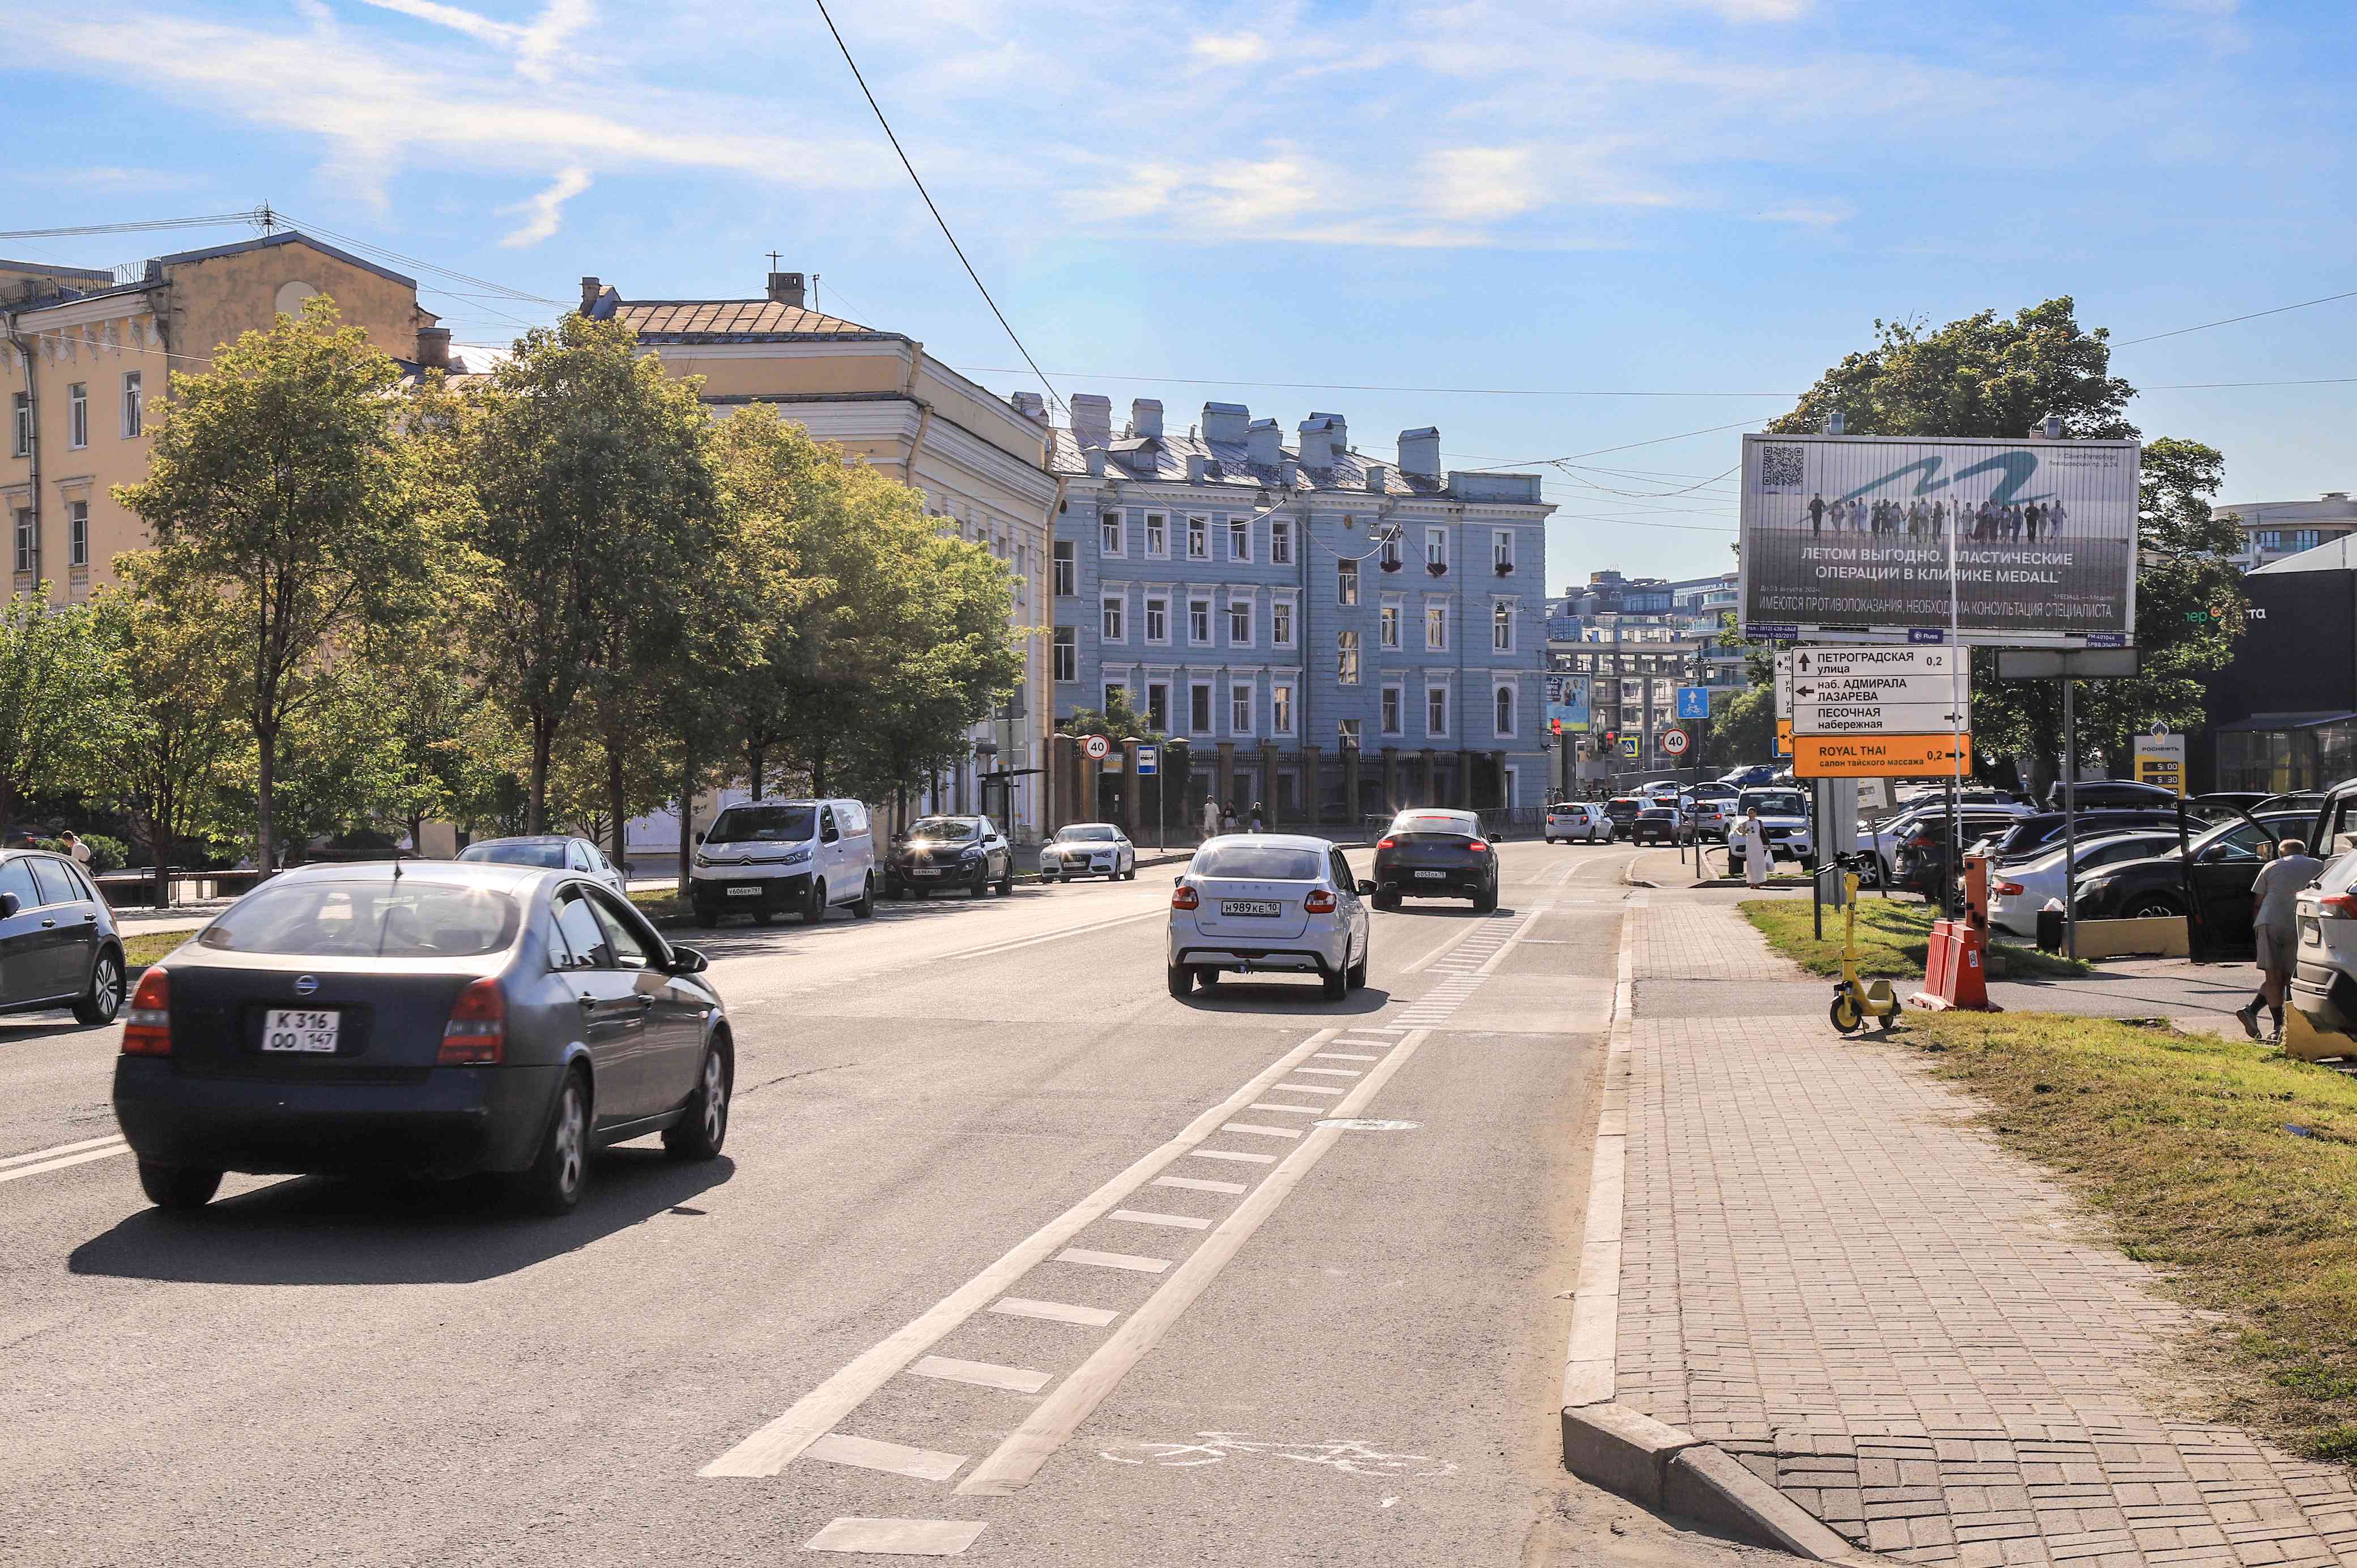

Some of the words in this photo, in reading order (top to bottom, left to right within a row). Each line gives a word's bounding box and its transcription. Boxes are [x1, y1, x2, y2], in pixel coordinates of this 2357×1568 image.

[1801, 547, 1856, 560] ЛЕТОМ
[1861, 548, 1943, 564] ВЫГОДНО.
[1815, 566, 1899, 581] ОПЕРАЦИИ
[1904, 568, 1913, 580] В
[1918, 568, 1992, 582] КЛИНИКЕ
[1759, 596, 1803, 610] ИМЕЮТСЯ
[1806, 597, 1904, 614] ПРОТИВОПОКАЗАНИЯ,
[1972, 601, 2043, 619] КОНСУЛЬТАЦИЯ
[2046, 602, 2113, 620] СПЕЦИАЛИСТА.
[1818, 652, 1913, 663] ПЕТРОГРАДСКАЯ
[1926, 657, 1942, 667] 0,2
[1818, 666, 1850, 675] улица
[1818, 680, 1840, 689] наб.
[1844, 679, 1907, 689] АДМИРАЛА
[1818, 692, 1878, 701] ЛАЗАРЕВА
[1818, 708, 1881, 717] ПЕСОЧНАЯ
[1818, 720, 1882, 730] набережная
[1091, 742, 1104, 752] 40
[1669, 736, 1683, 747] 40
[1819, 747, 1857, 756] ROYAL
[1860, 746, 1886, 755] THAI
[1927, 751, 1942, 761] 0,2
[276, 1012, 290, 1028] К
[295, 1013, 327, 1029] 316
[308, 1033, 333, 1045] 147
